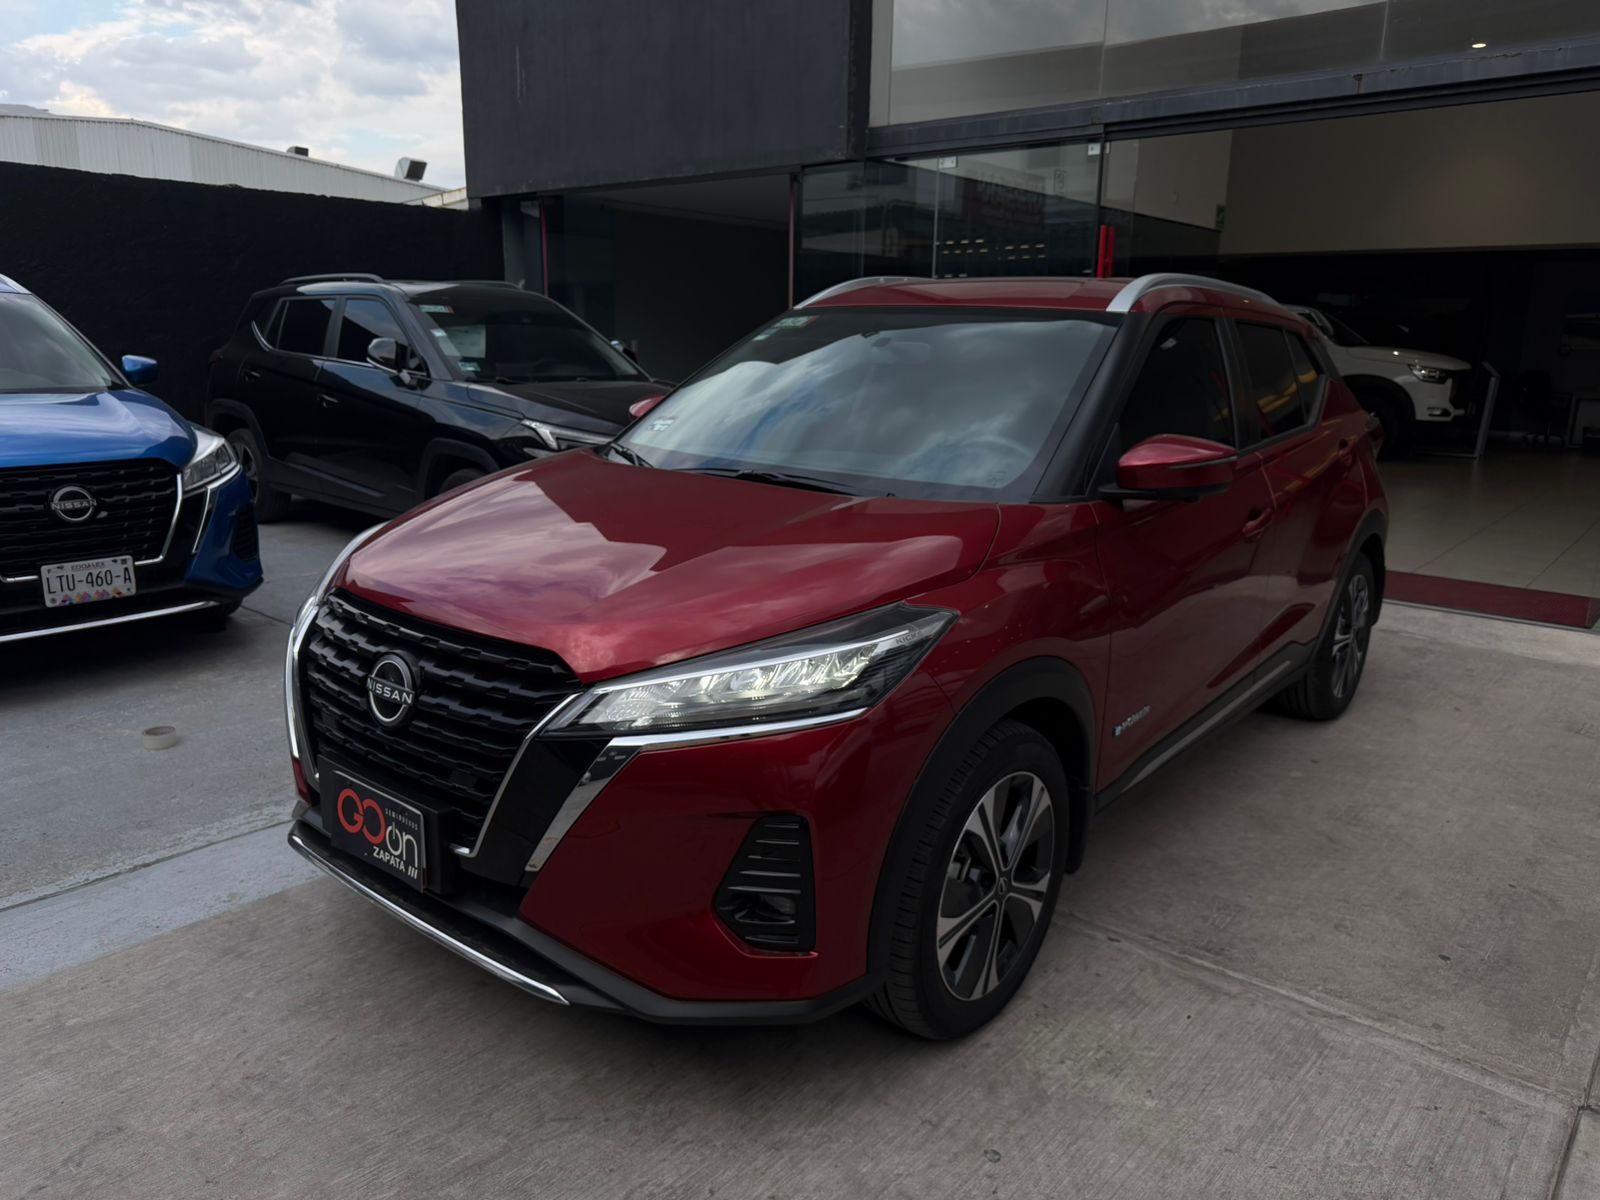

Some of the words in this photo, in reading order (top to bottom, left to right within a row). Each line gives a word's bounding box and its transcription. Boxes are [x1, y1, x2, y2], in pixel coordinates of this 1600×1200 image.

[51, 500, 97, 511] NISSAN
[47, 567, 132, 594] LTU-460-A
[367, 678, 413, 705] NISSAN
[373, 846, 405, 872] ZAPATA
[408, 865, 418, 880] III
